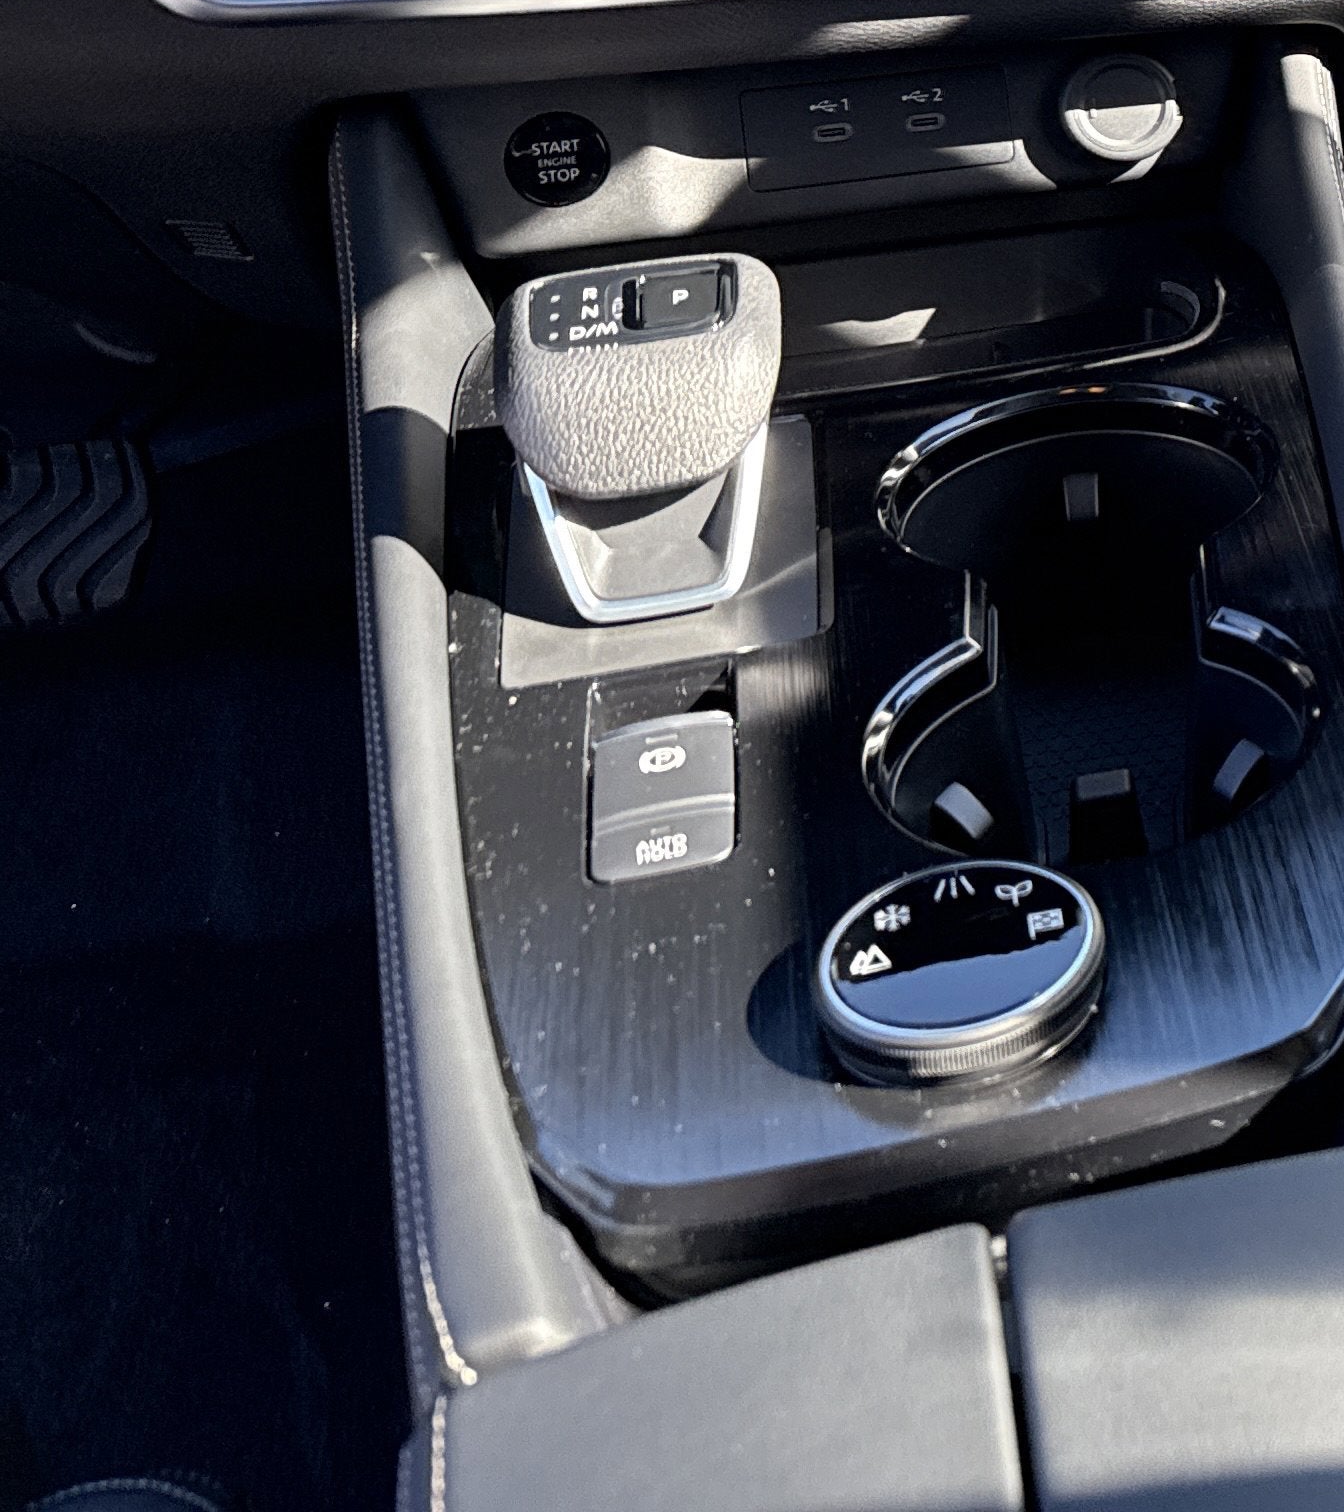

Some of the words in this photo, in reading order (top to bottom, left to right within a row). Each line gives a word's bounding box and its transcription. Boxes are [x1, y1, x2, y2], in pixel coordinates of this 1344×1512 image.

[932, 88, 944, 102] 2
[840, 98, 849, 111] 1
[531, 139, 580, 156] START
[537, 156, 577, 168] ENGINE
[538, 167, 580, 184] STOP
[582, 286, 598, 302] R
[672, 289, 689, 305] P
[581, 303, 599, 320] N
[569, 321, 619, 341] D/M
